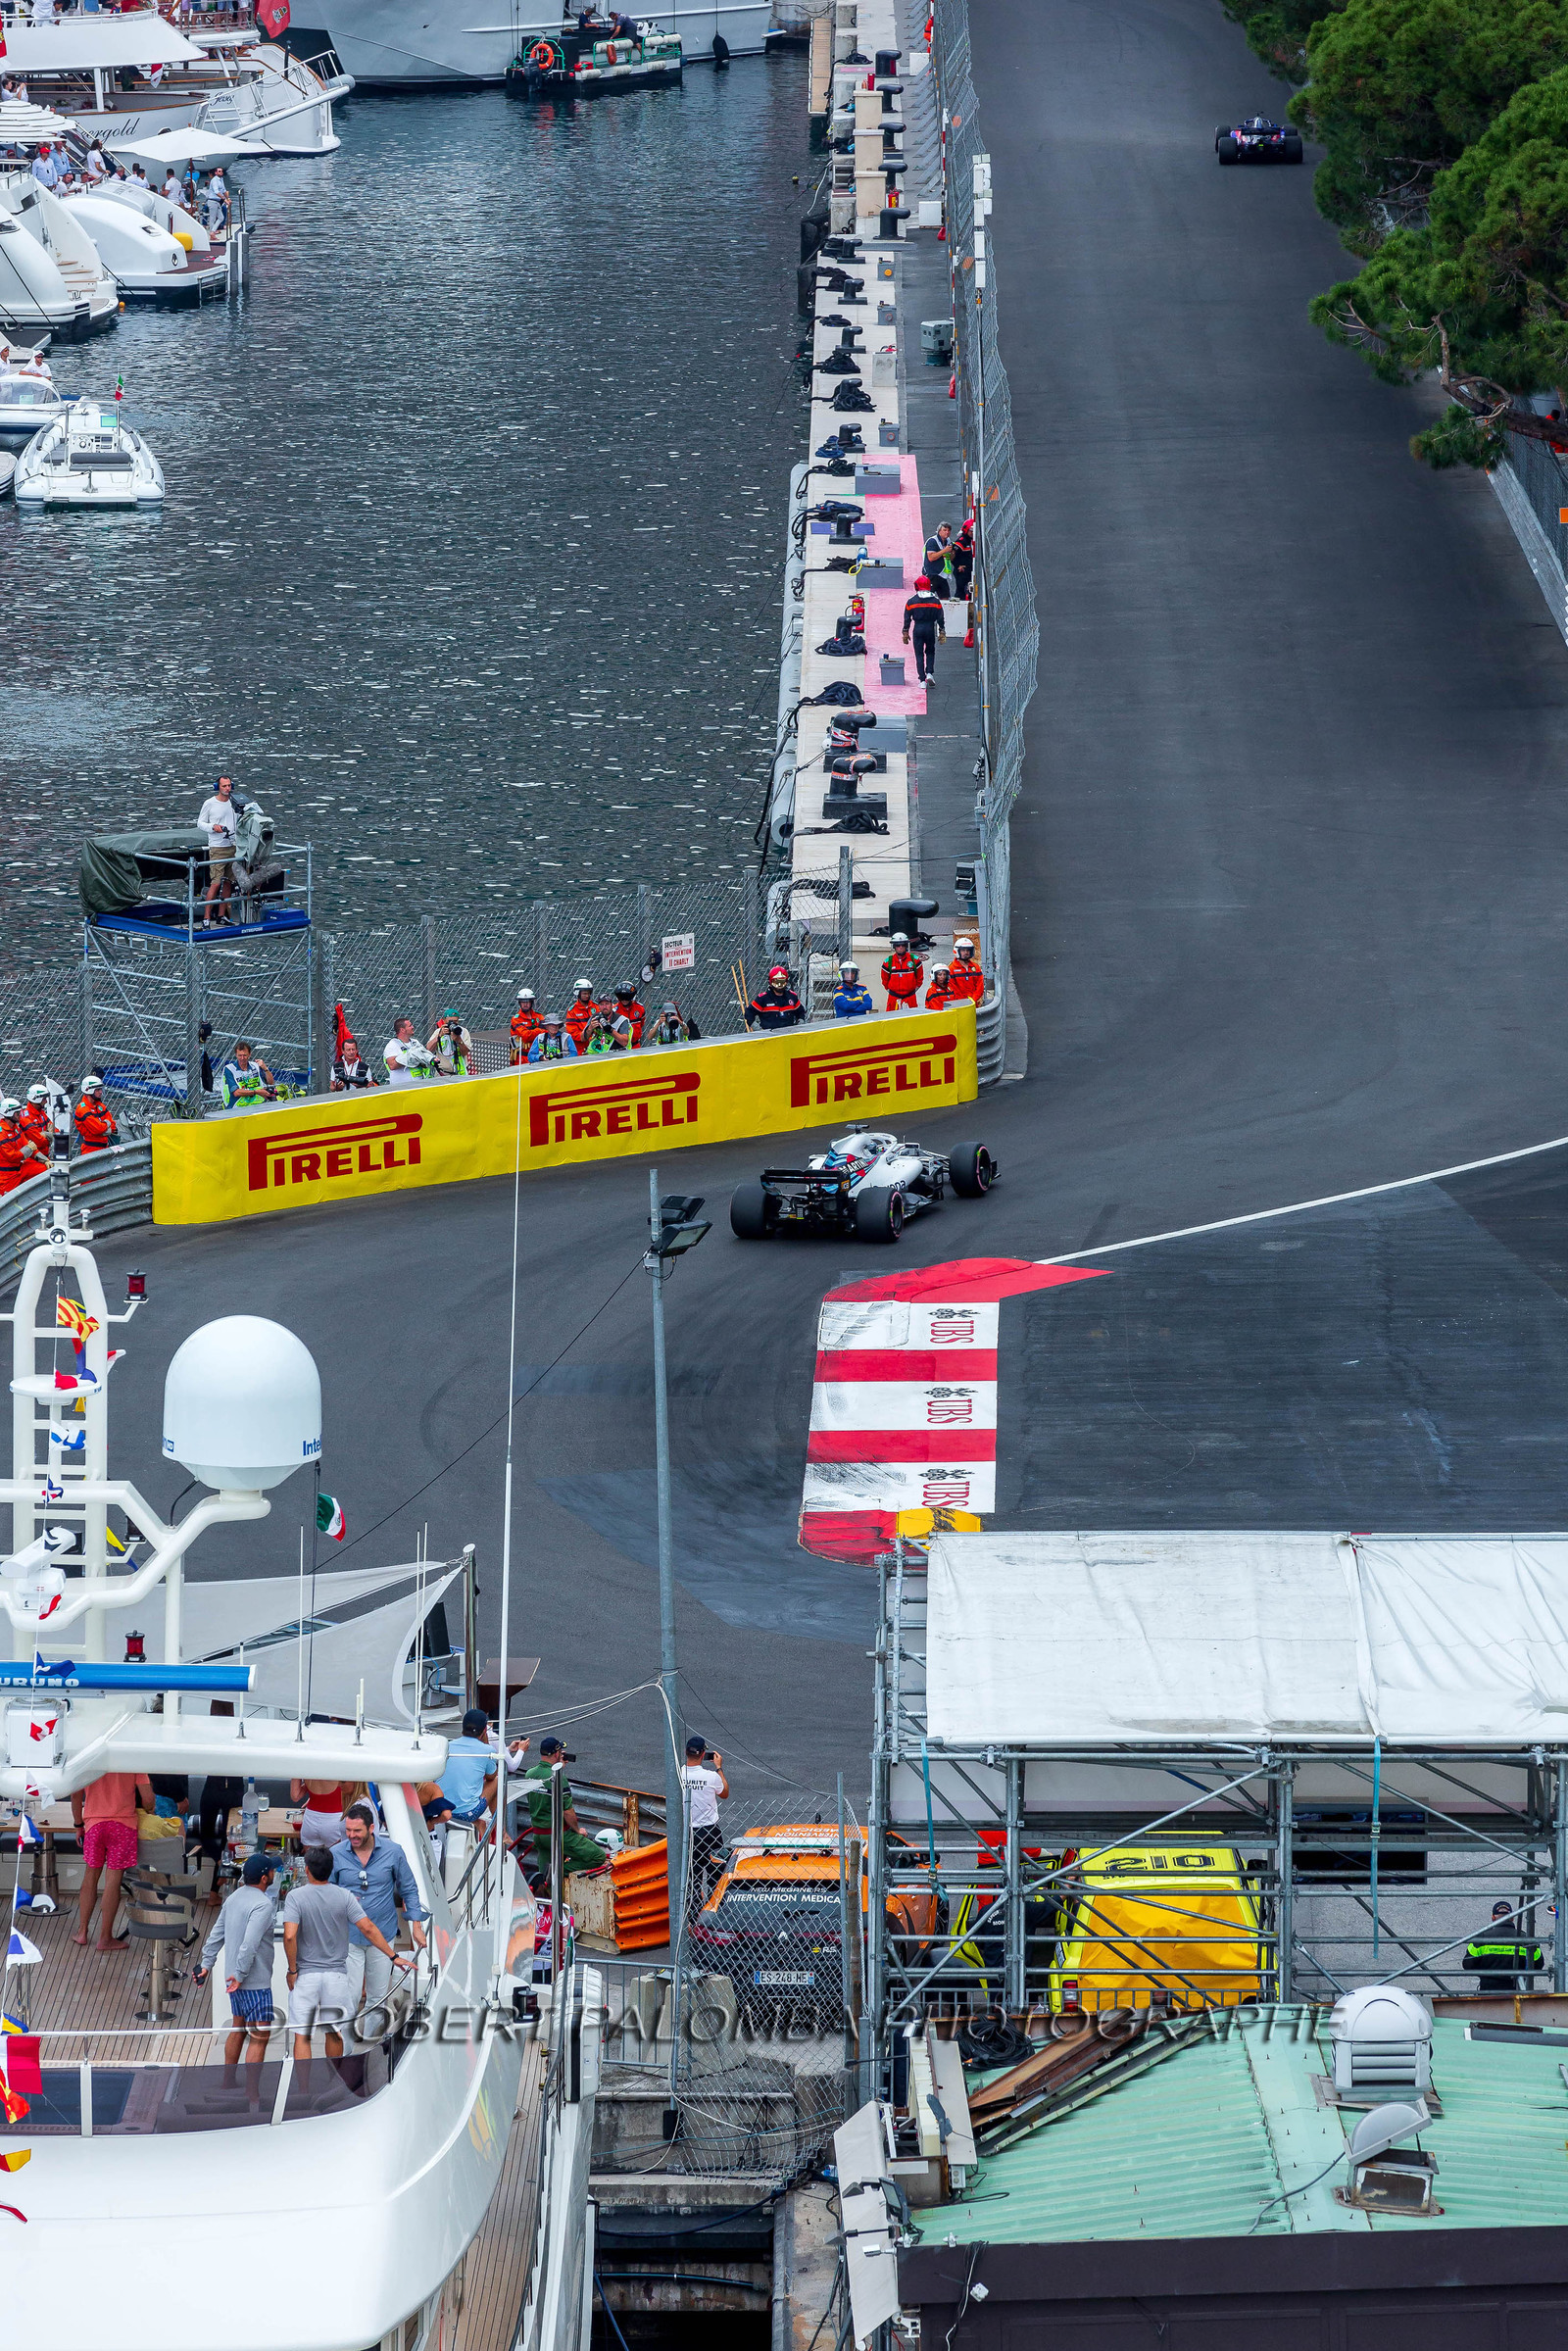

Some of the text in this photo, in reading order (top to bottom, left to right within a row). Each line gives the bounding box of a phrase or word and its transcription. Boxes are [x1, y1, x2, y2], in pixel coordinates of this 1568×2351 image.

[665, 949, 692, 957] INTERVENTION
[791, 1034, 957, 1108] PIRELLI
[529, 1071, 701, 1147] PIRELLI
[248, 1113, 423, 1191] PIRELLI
[930, 1320, 974, 1344] UBS
[927, 1398, 972, 1424] UBS
[921, 1481, 970, 1507] UBS
[726, 1893, 841, 1904] INTERVENTION MEDICA
